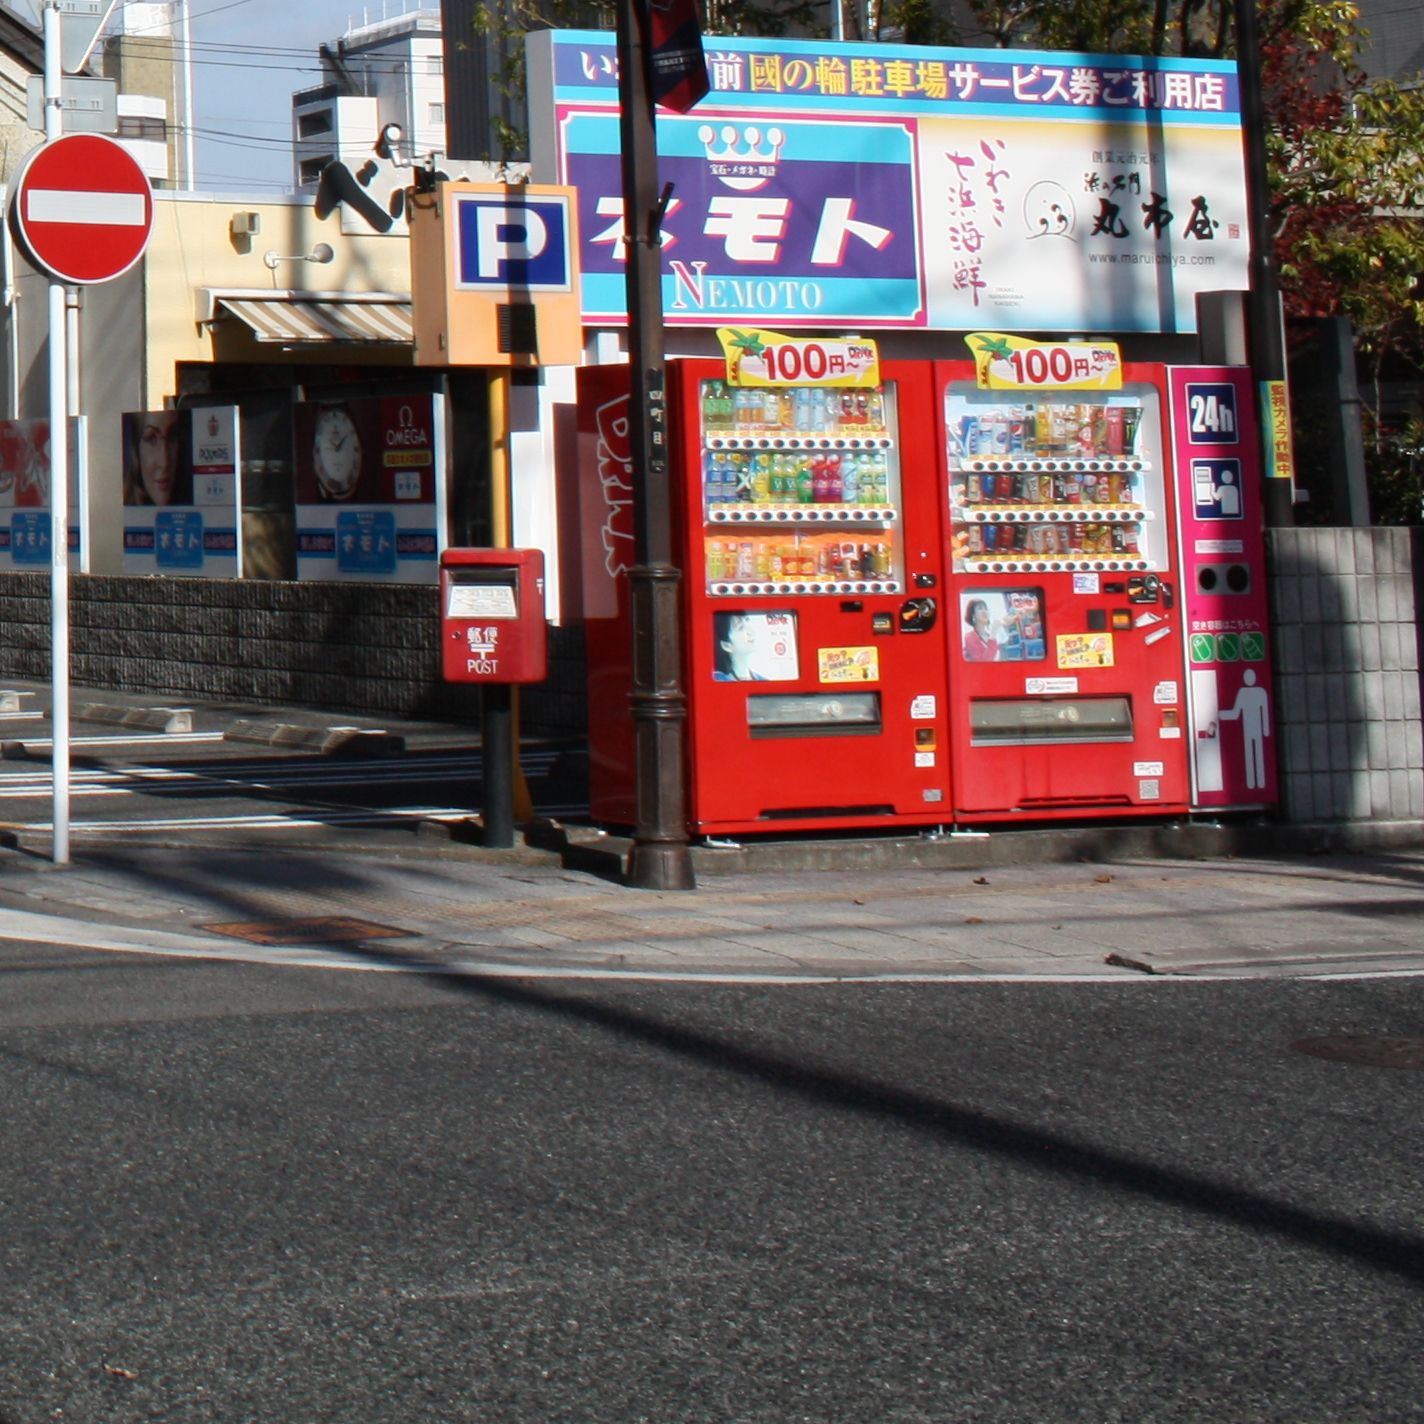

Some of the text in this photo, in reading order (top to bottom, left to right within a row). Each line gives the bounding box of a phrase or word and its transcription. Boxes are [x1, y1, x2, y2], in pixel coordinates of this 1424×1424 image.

[476, 205, 549, 279] P
[1087, 253, 1216, 268] www.maruichiya.com
[1190, 394, 1234, 433] 24h
[385, 429, 428, 446] OMEGA
[1271, 383, 1290, 475] 監視カメラ作動中
[467, 626, 499, 644] 郵便
[467, 659, 499, 675] POST
